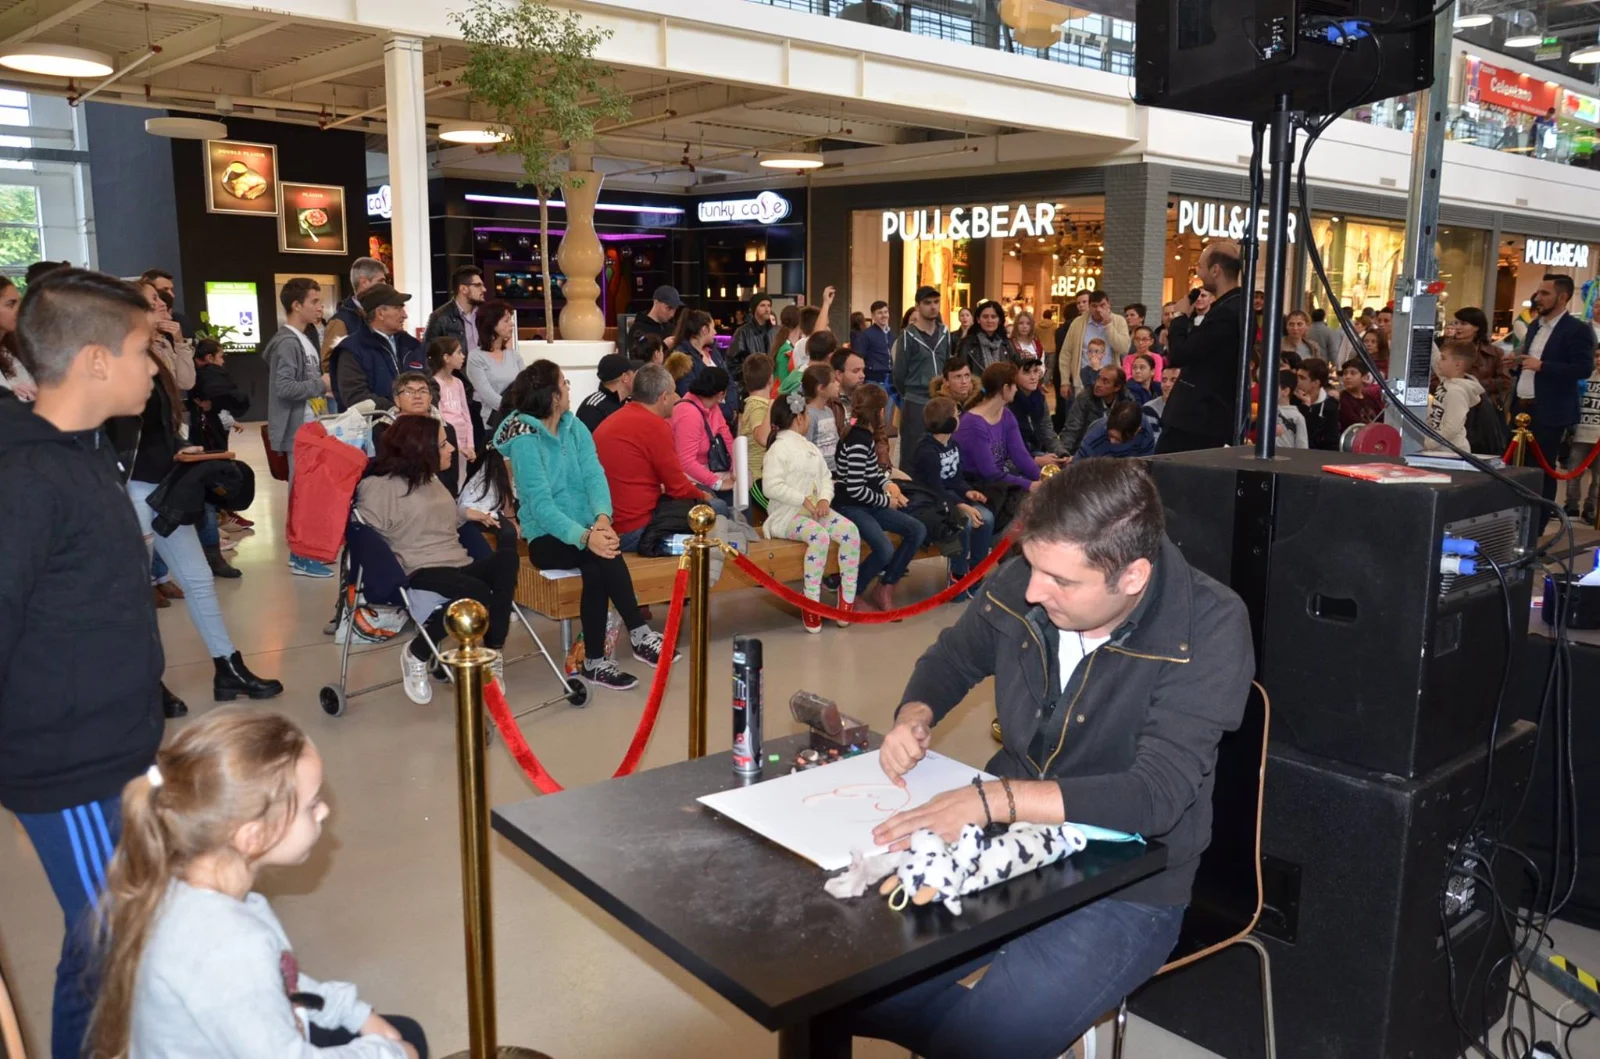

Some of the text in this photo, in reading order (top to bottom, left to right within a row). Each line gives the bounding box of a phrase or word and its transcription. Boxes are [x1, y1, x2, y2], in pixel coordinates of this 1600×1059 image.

[700, 201, 735, 220] funky
[881, 202, 1056, 243] PULL&BEAR
[1178, 200, 1297, 244] PULL&ER
[1525, 239, 1589, 268] PULL&BEAR
